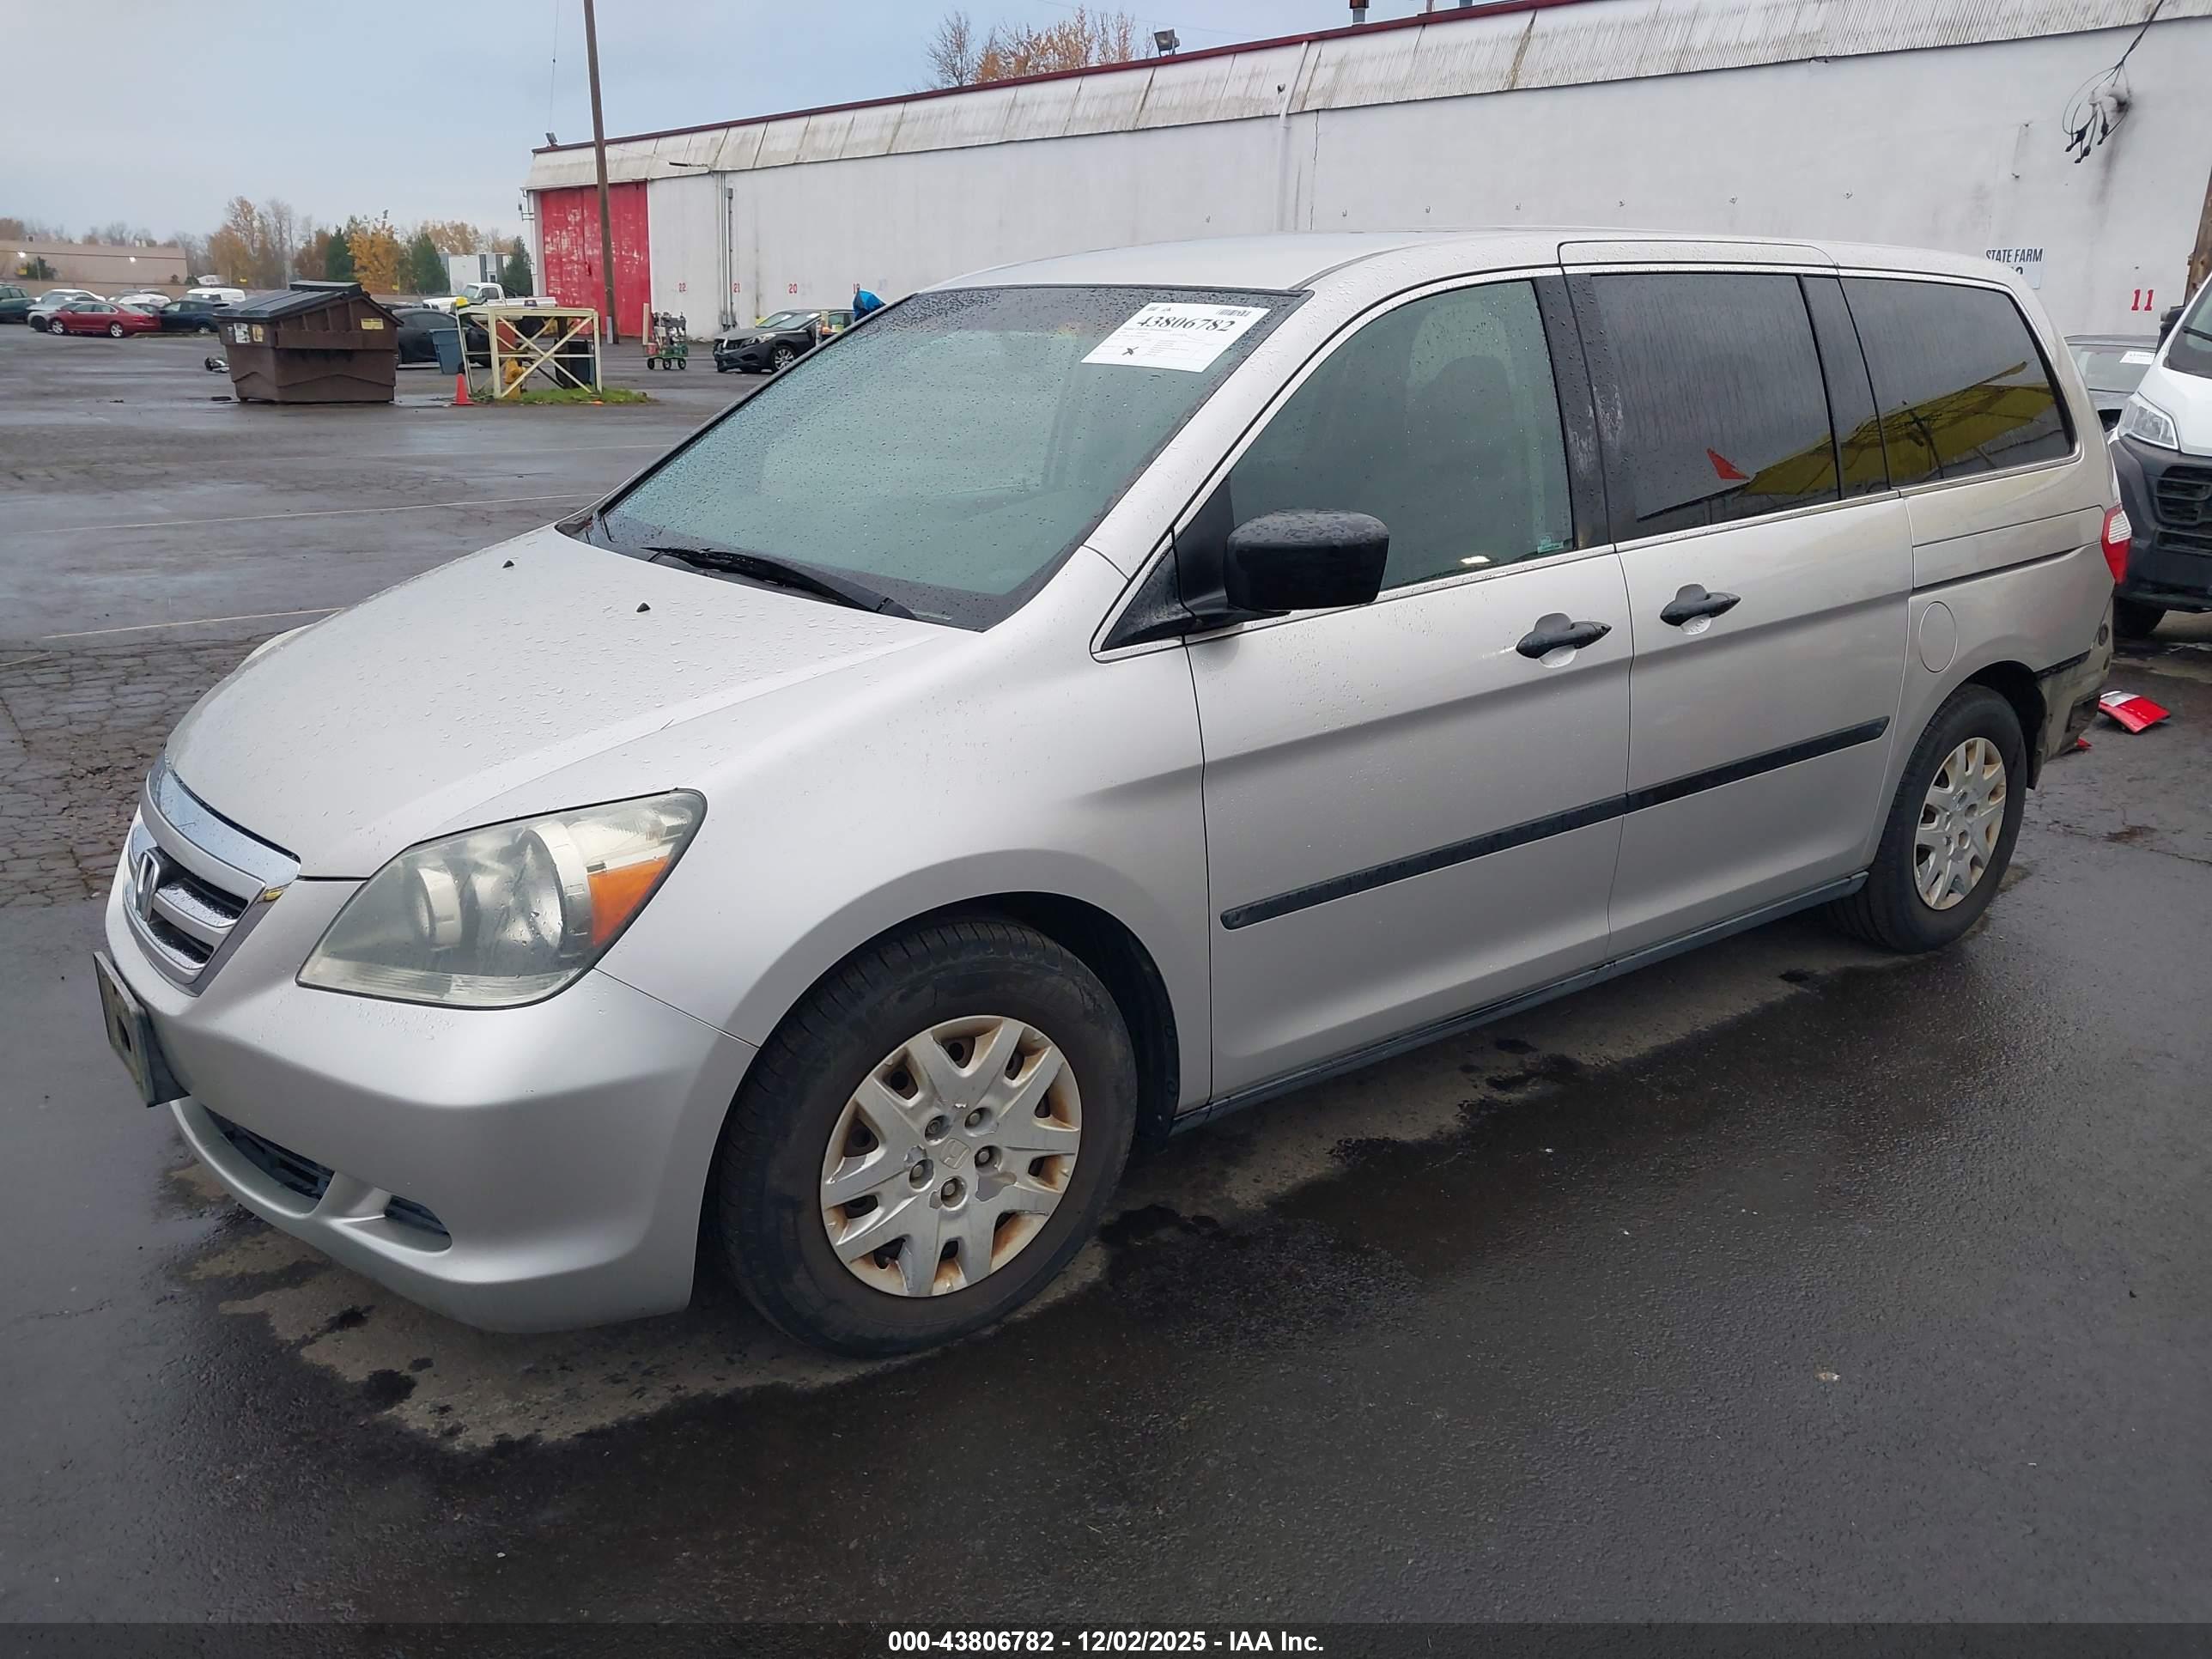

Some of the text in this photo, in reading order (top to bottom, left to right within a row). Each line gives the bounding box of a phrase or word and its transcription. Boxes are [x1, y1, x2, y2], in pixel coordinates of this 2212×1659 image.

[1985, 248, 2044, 263] STATE FARM
[788, 283, 798, 294] 20
[2130, 289, 2154, 311] 11
[1136, 315, 1237, 332] 43806782
